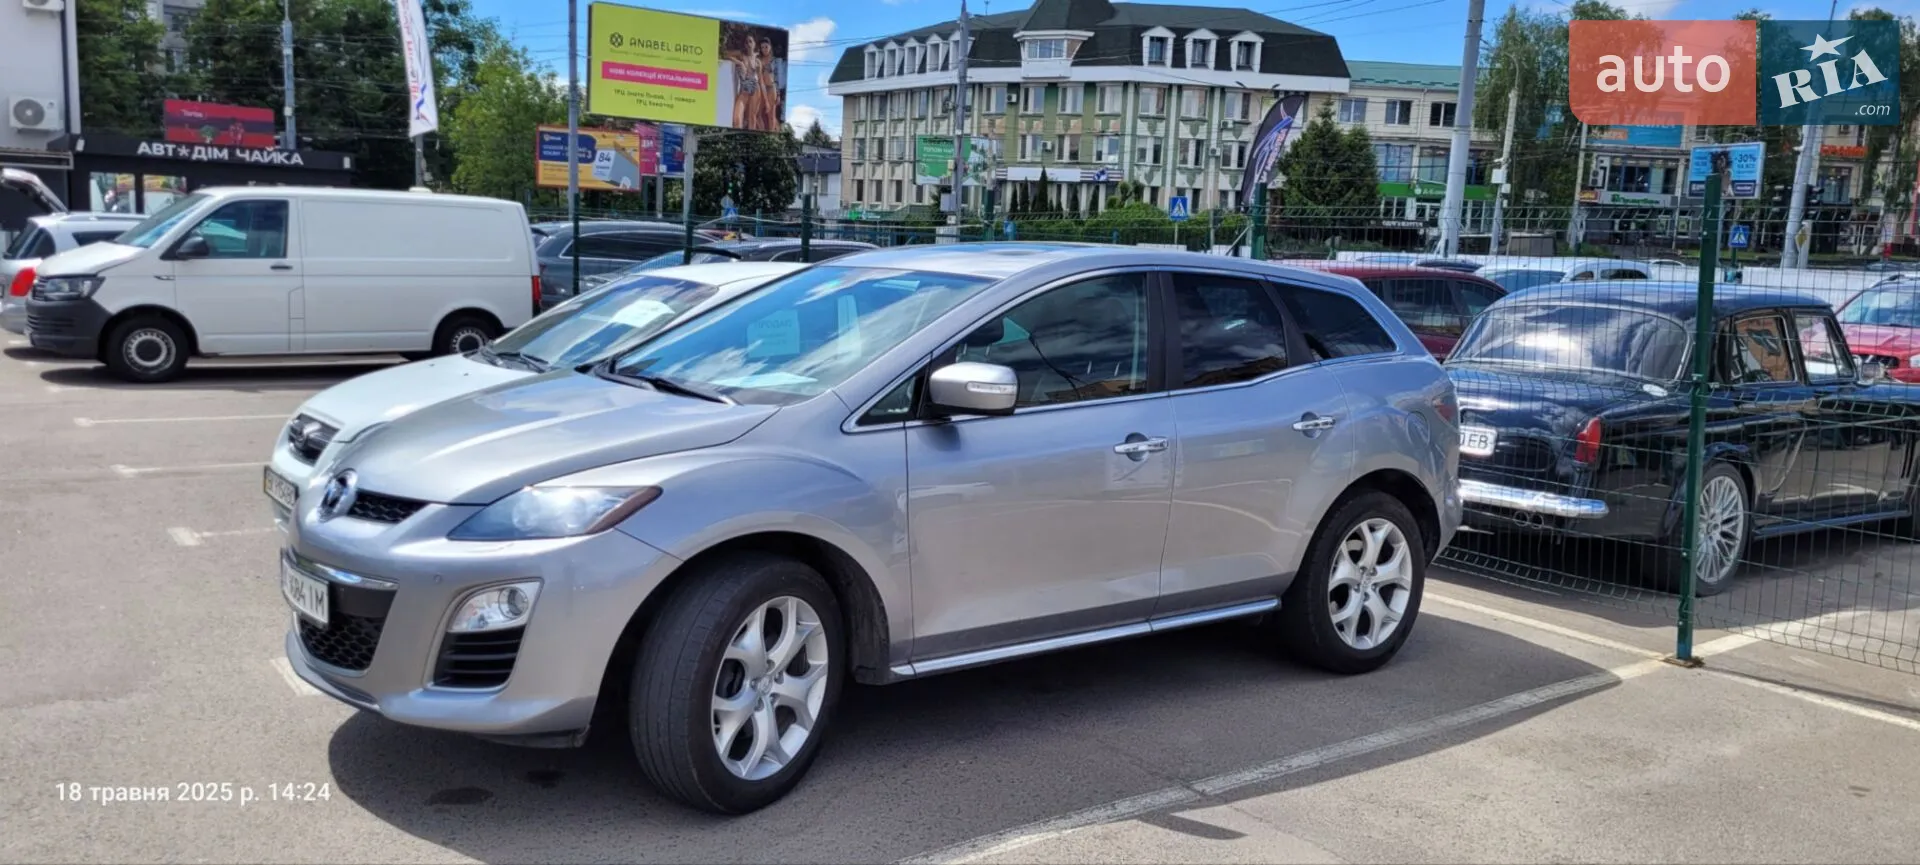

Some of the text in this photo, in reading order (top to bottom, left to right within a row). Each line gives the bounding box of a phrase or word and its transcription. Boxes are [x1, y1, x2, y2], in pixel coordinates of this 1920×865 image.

[629, 37, 672, 53] ANABEL
[674, 43, 703, 56] ARTO
[235, 145, 304, 166] ЧАЙКА
